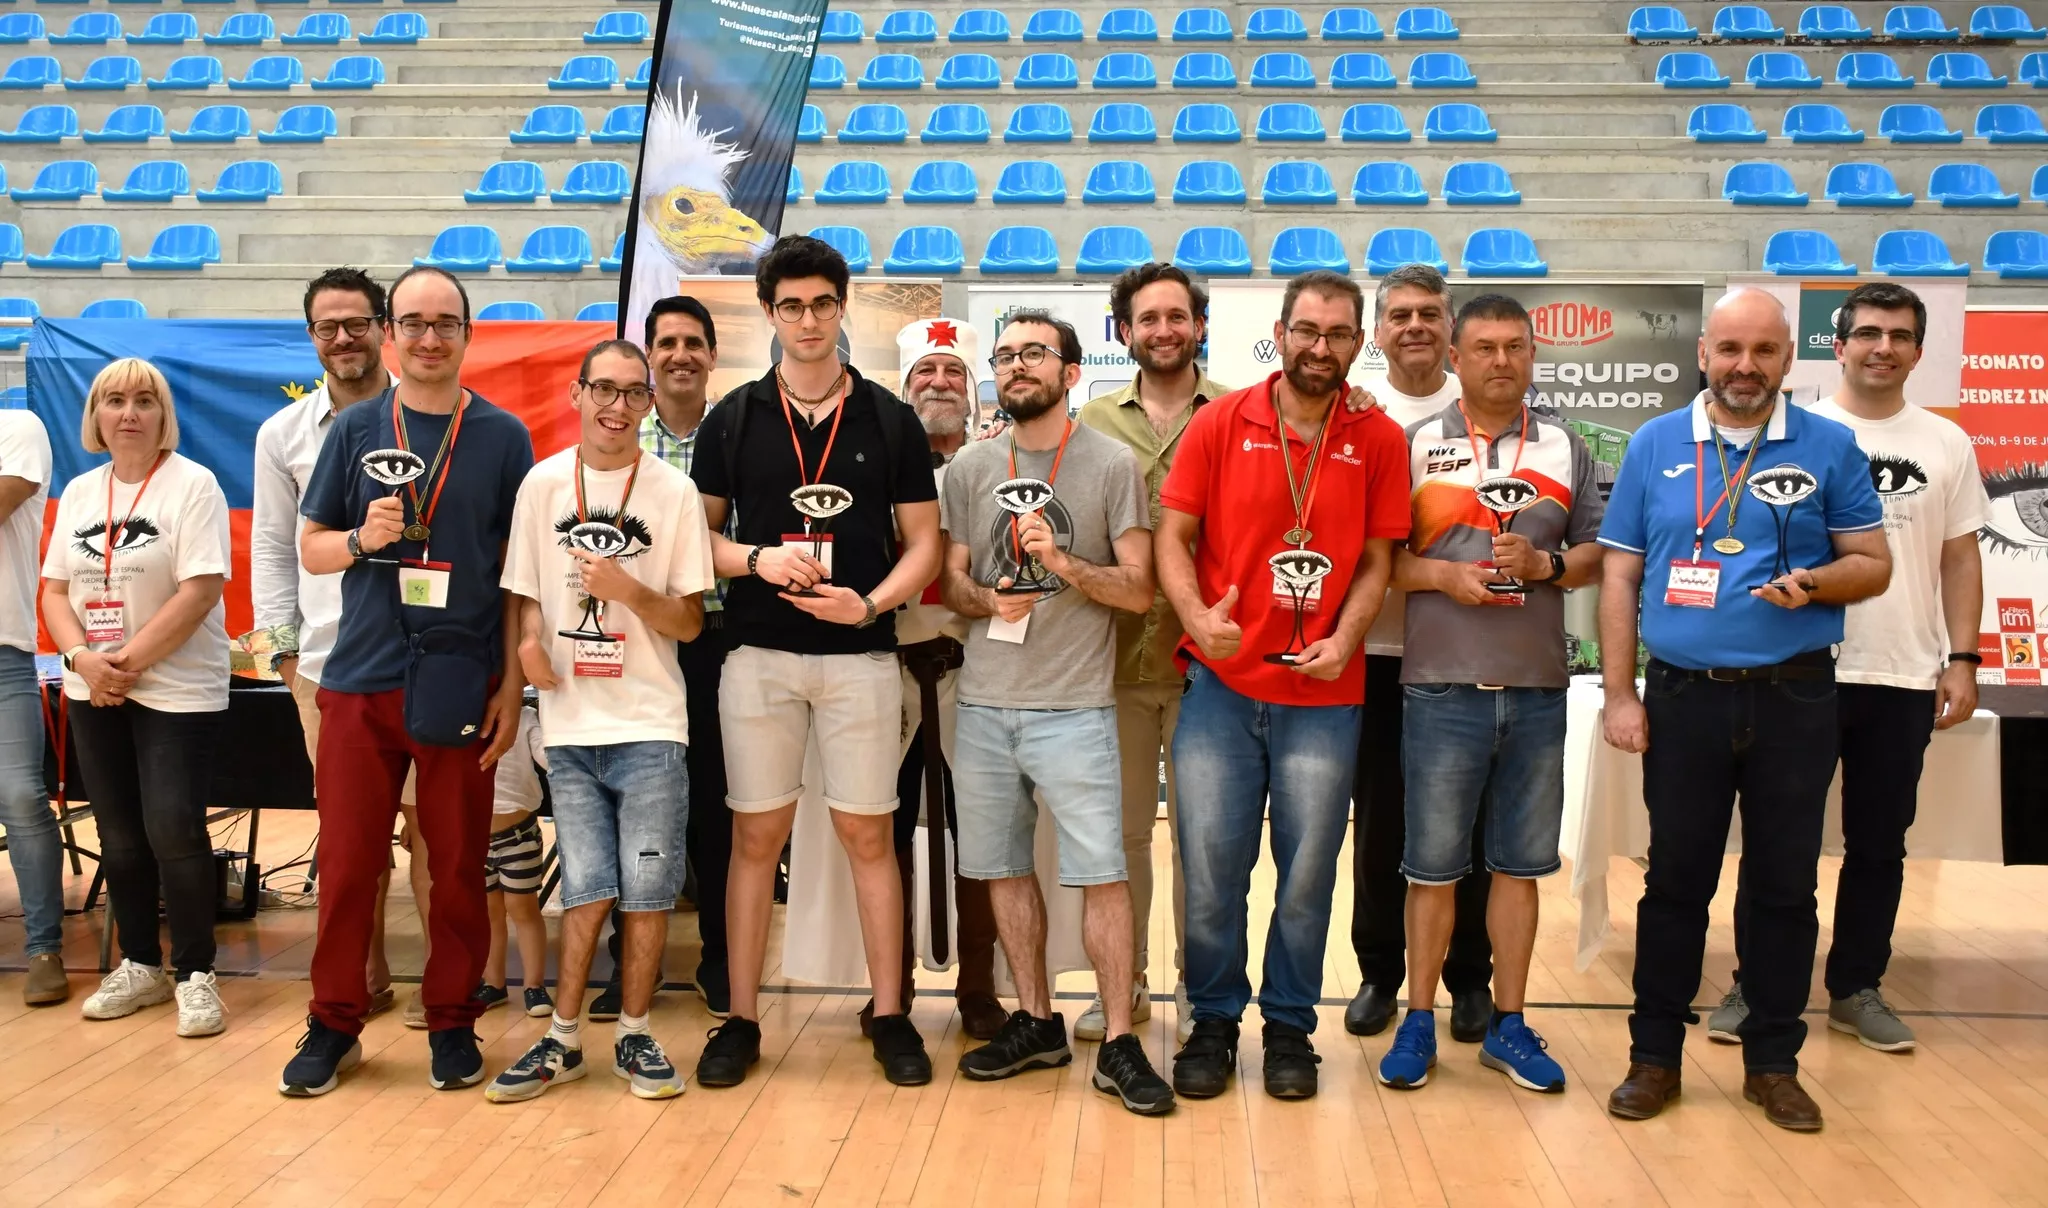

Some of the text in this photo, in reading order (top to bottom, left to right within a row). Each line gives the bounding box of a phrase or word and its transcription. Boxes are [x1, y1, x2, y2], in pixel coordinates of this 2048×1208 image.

[1528, 303, 1613, 338] TATOMA
[1080, 353, 1136, 365] olution
[1961, 354, 2045, 370] PEONATO
[1533, 362, 1680, 387] EQUIPO
[1960, 388, 2048, 404] JEDREZ IN
[1969, 433, 1997, 446] ZÓN,
[1999, 435, 2021, 446] 8-9
[2023, 436, 2038, 446] DE
[1428, 446, 1457, 457] vive
[1426, 458, 1472, 474] ESP
